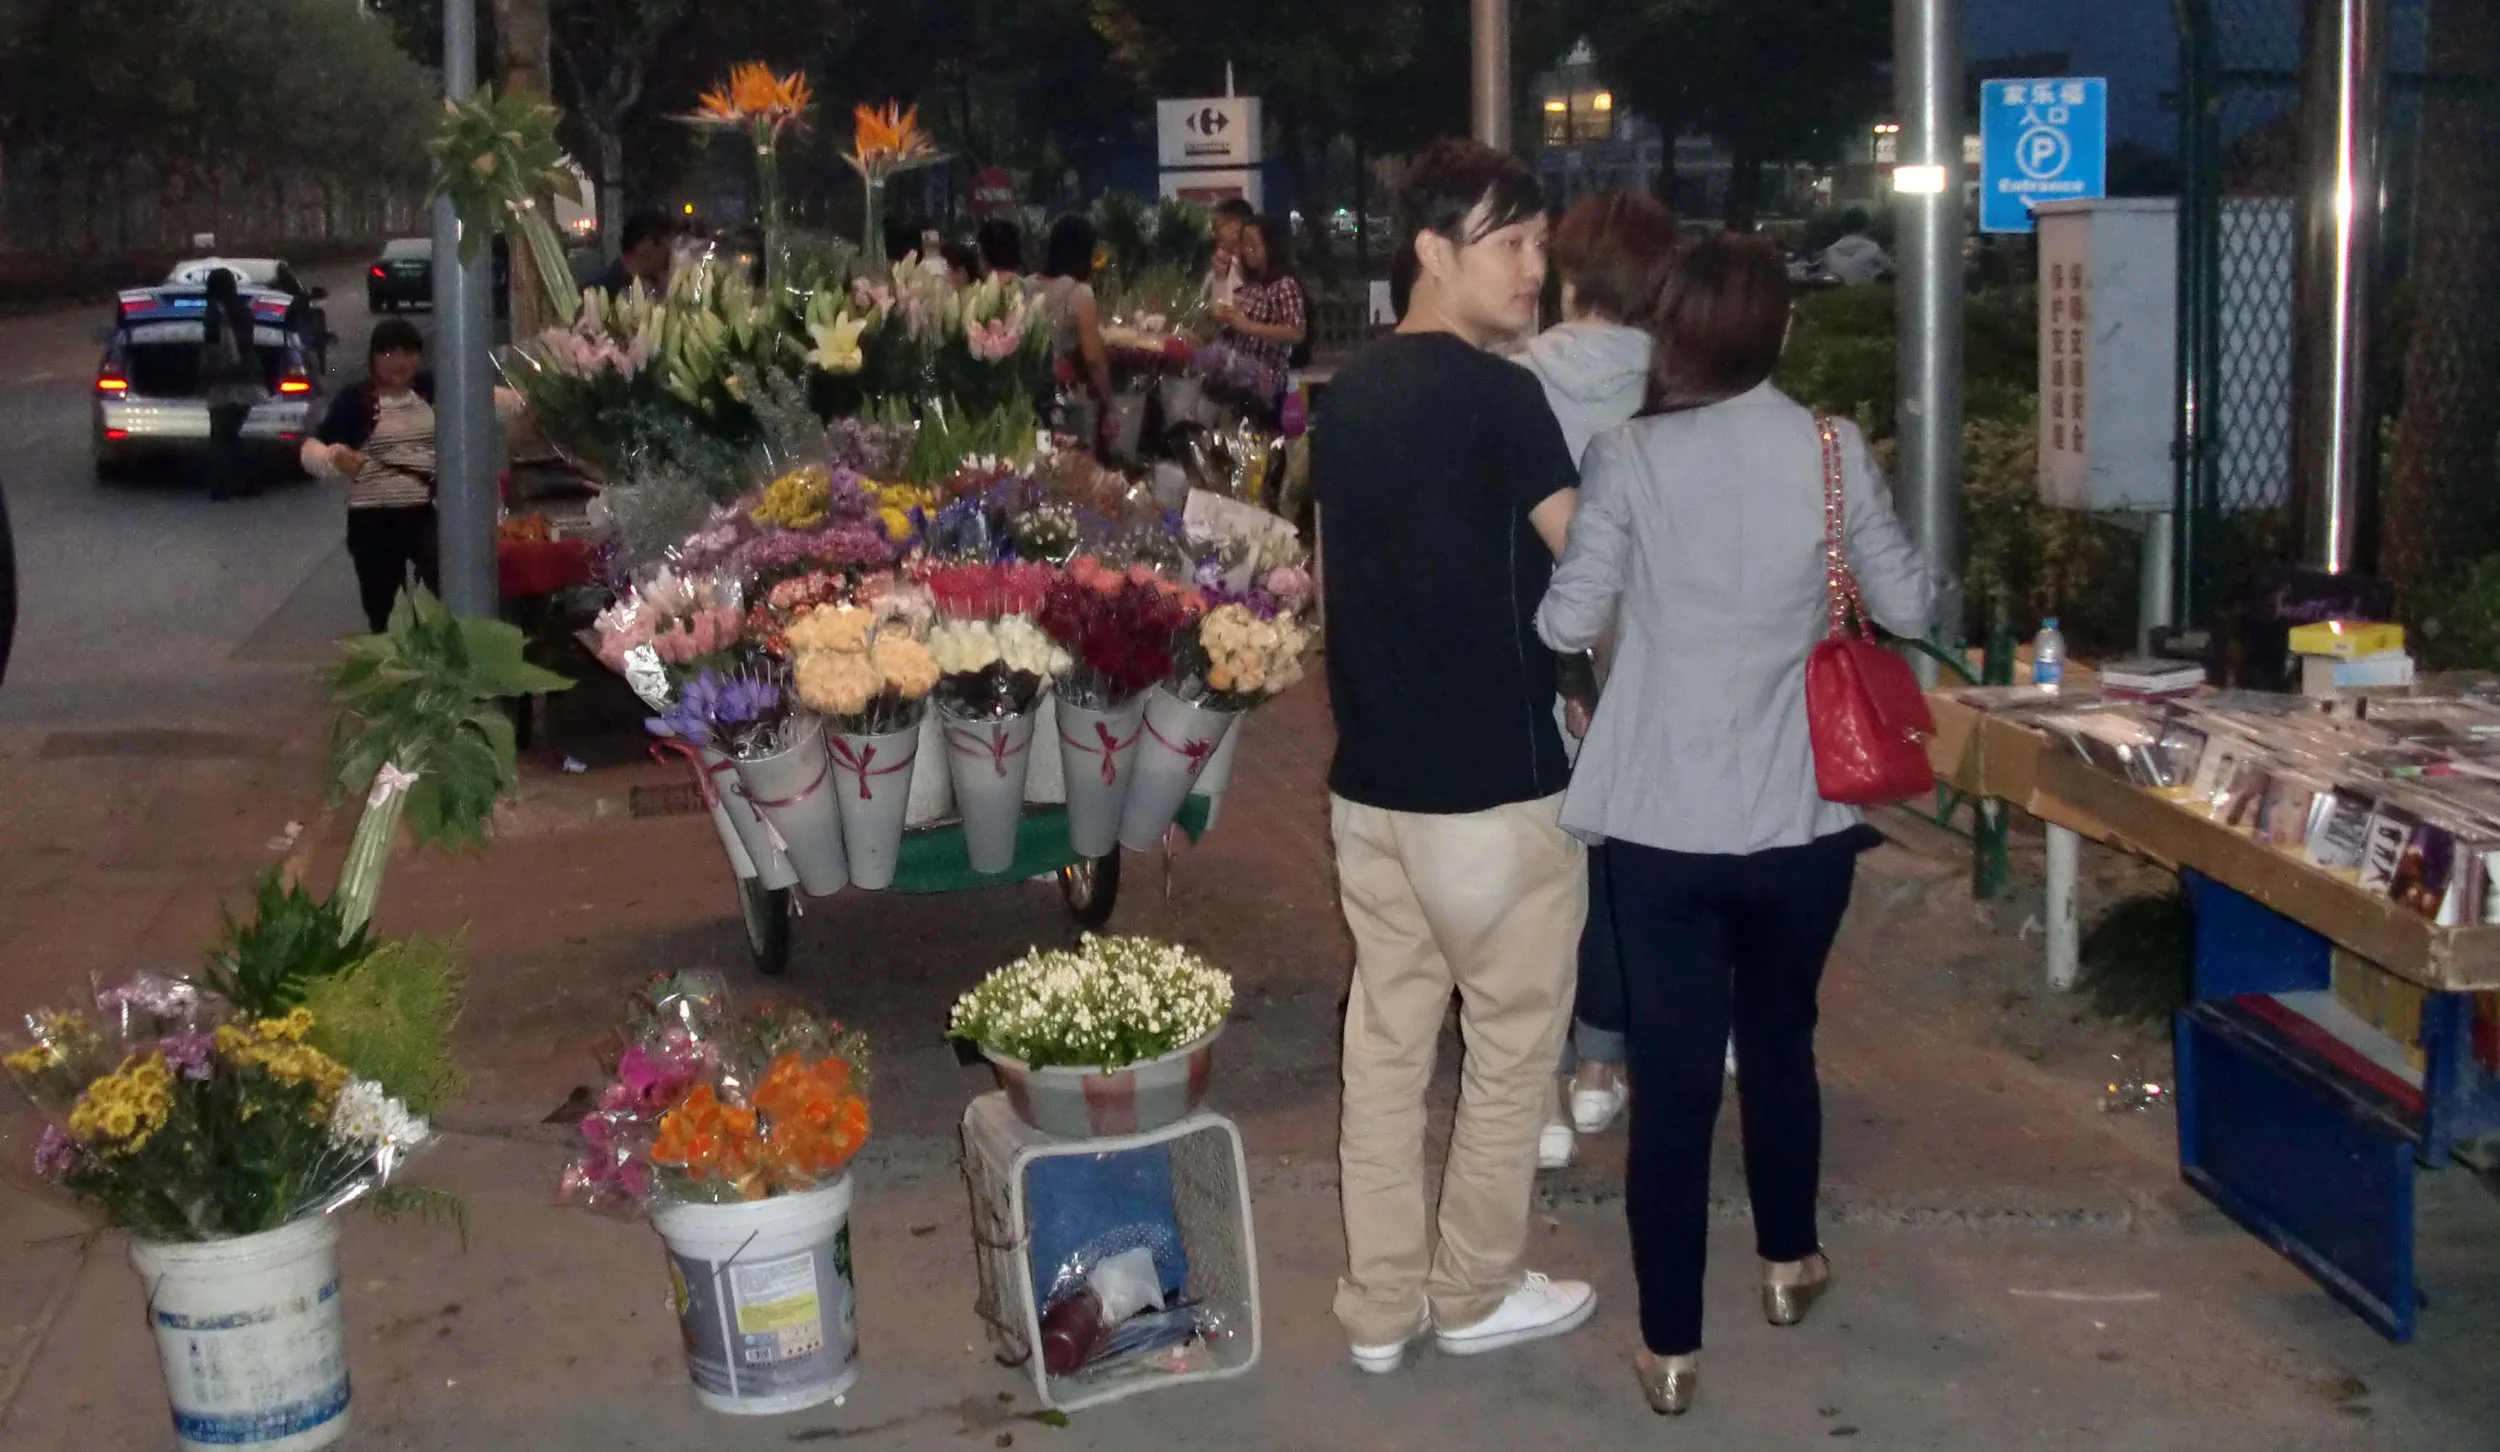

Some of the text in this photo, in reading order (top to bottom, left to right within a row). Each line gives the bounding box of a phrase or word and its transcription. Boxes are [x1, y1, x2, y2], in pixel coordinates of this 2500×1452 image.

[2018, 106, 2070, 126] 入口
[2030, 137, 2057, 169] P
[1998, 177, 2086, 193] Entrance
